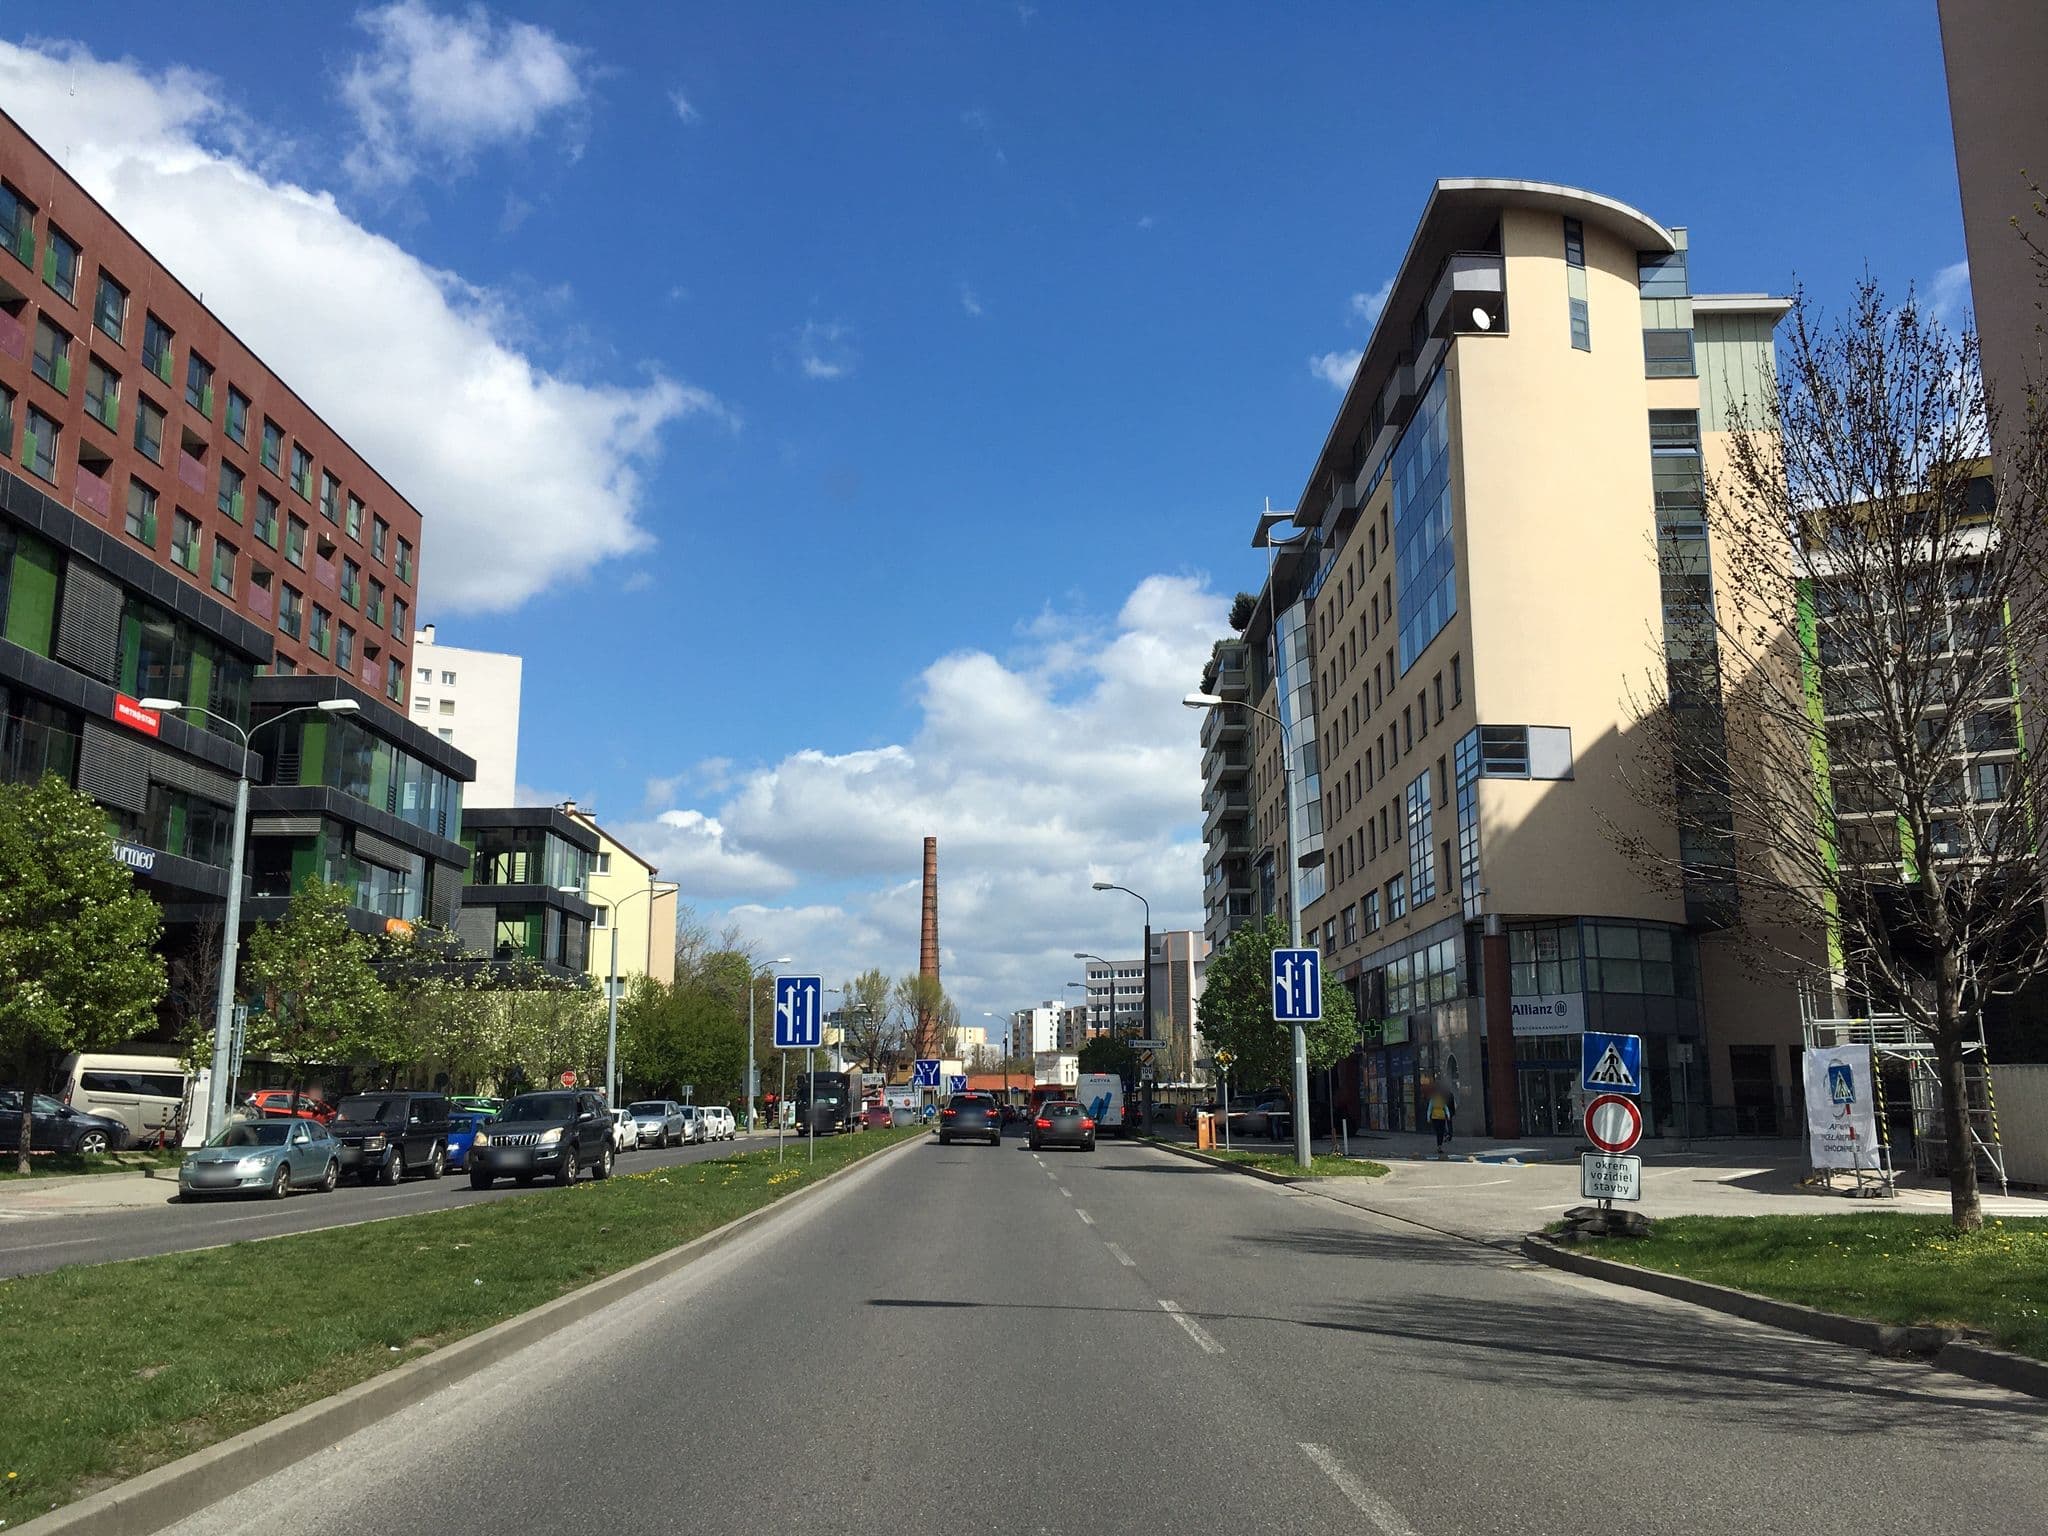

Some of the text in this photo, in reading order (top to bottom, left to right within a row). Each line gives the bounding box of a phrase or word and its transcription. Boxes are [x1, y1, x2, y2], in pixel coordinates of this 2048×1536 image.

[1512, 1004, 1553, 1016] Allianz
[1595, 1161, 1628, 1171] okrem
[1590, 1172, 1633, 1183] vozidiel
[1594, 1183, 1629, 1195] stavby
